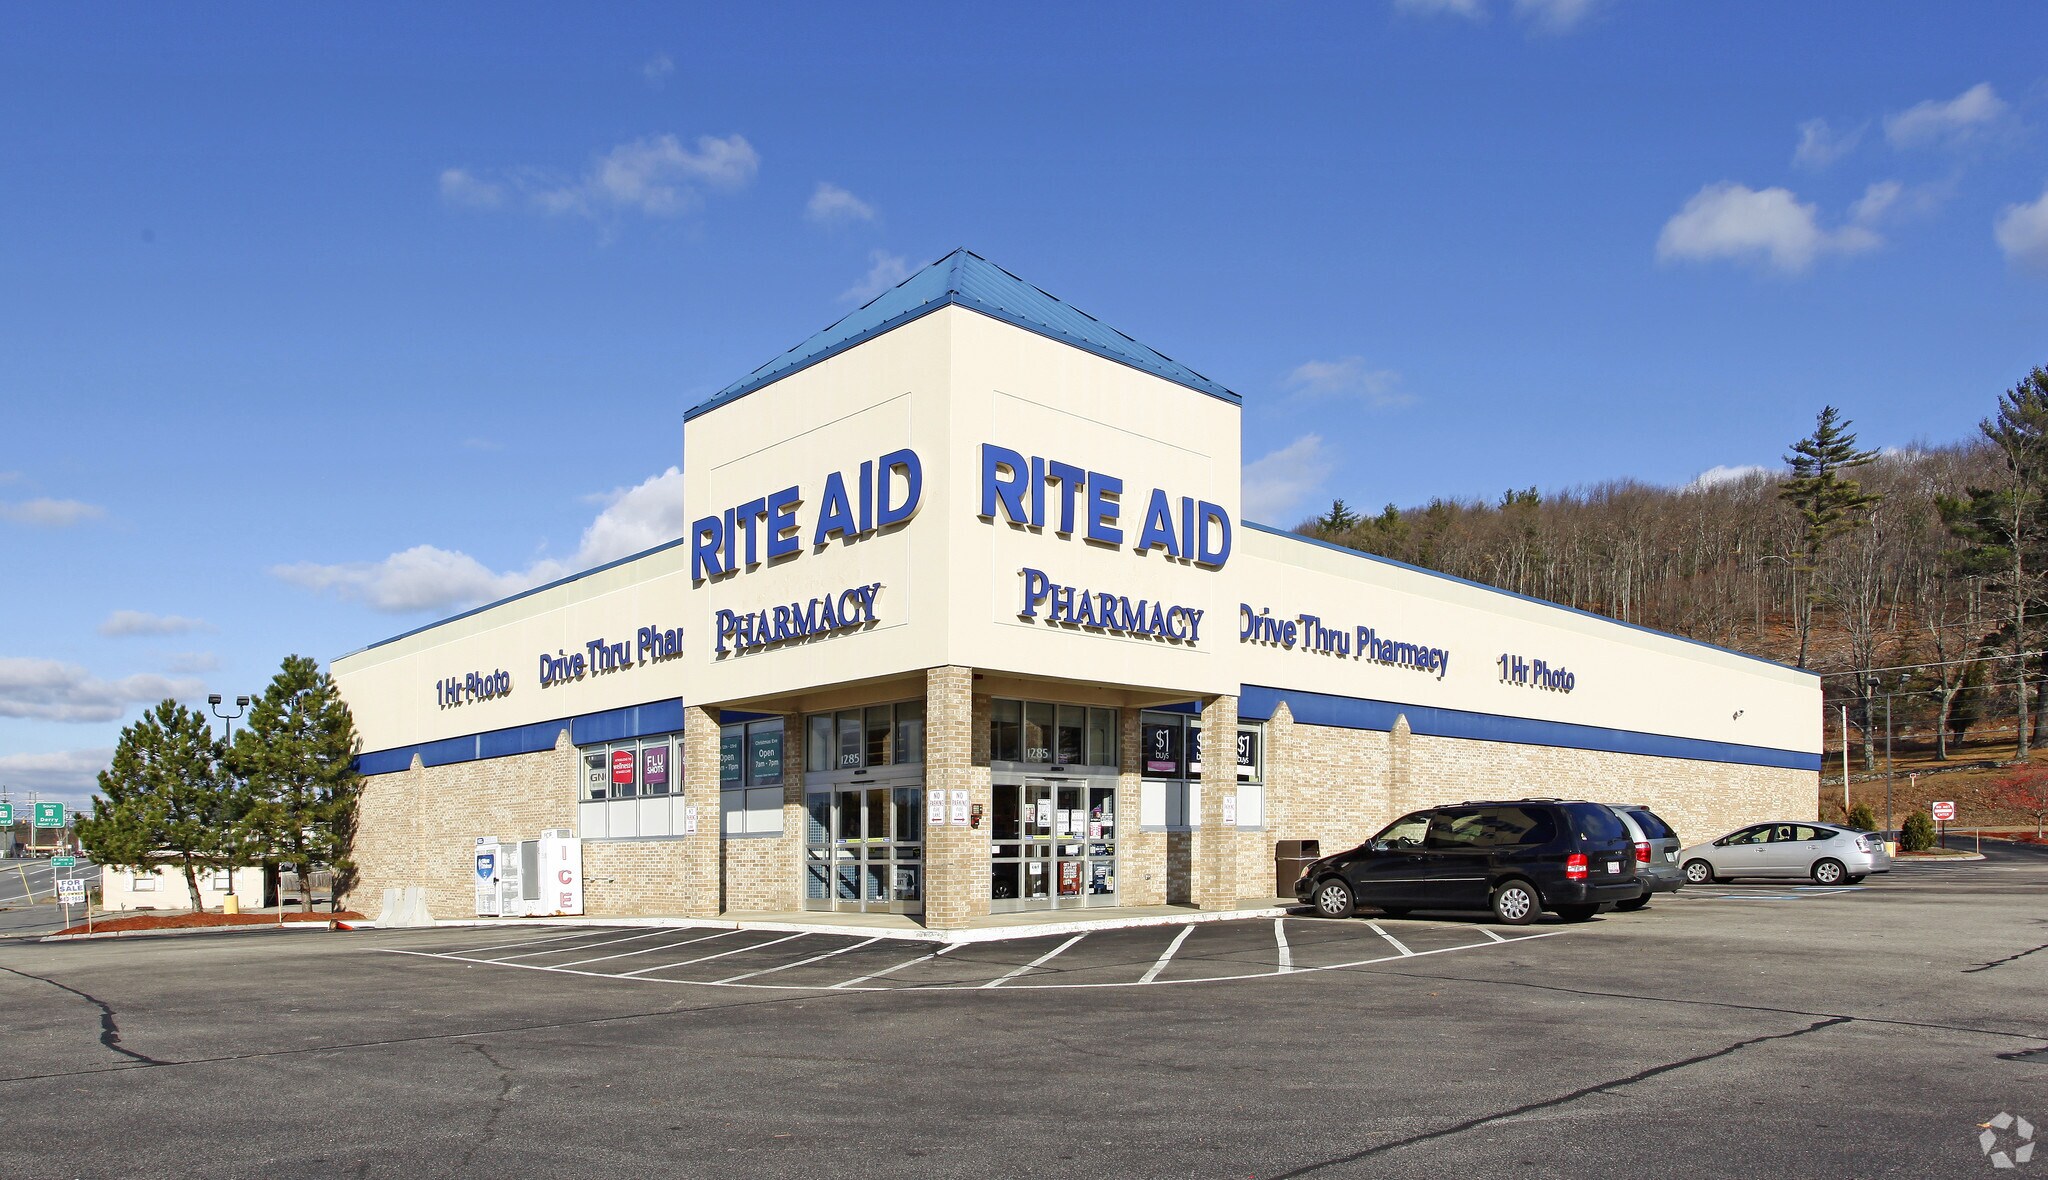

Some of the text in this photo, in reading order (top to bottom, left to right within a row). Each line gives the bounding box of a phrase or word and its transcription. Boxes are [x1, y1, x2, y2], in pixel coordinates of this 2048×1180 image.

[692, 448, 923, 581] RITE AID
[982, 443, 1232, 566] RITE AID
[1022, 567, 1205, 641] PHARMACY
[715, 582, 881, 652] PHARMACY
[1240, 603, 1449, 677] Drive Thru Pharmacy
[540, 649, 584, 684] Drive
[586, 638, 631, 672] Thru
[1499, 654, 1575, 691] 1 Hr Photo
[436, 668, 511, 705] 1 Hr Photo
[1156, 729, 1169, 752] $1
[1238, 735, 1249, 757] $1
[647, 754, 664, 767] FLU
[720, 754, 734, 763] Open
[759, 749, 774, 758] Open
[841, 753, 860, 765] 1285
[1027, 748, 1048, 758] 1285
[1155, 750, 1169, 760] buys
[590, 773, 606, 782] GN
[647, 765, 664, 774] SHOTS
[558, 846, 573, 908] ICE
